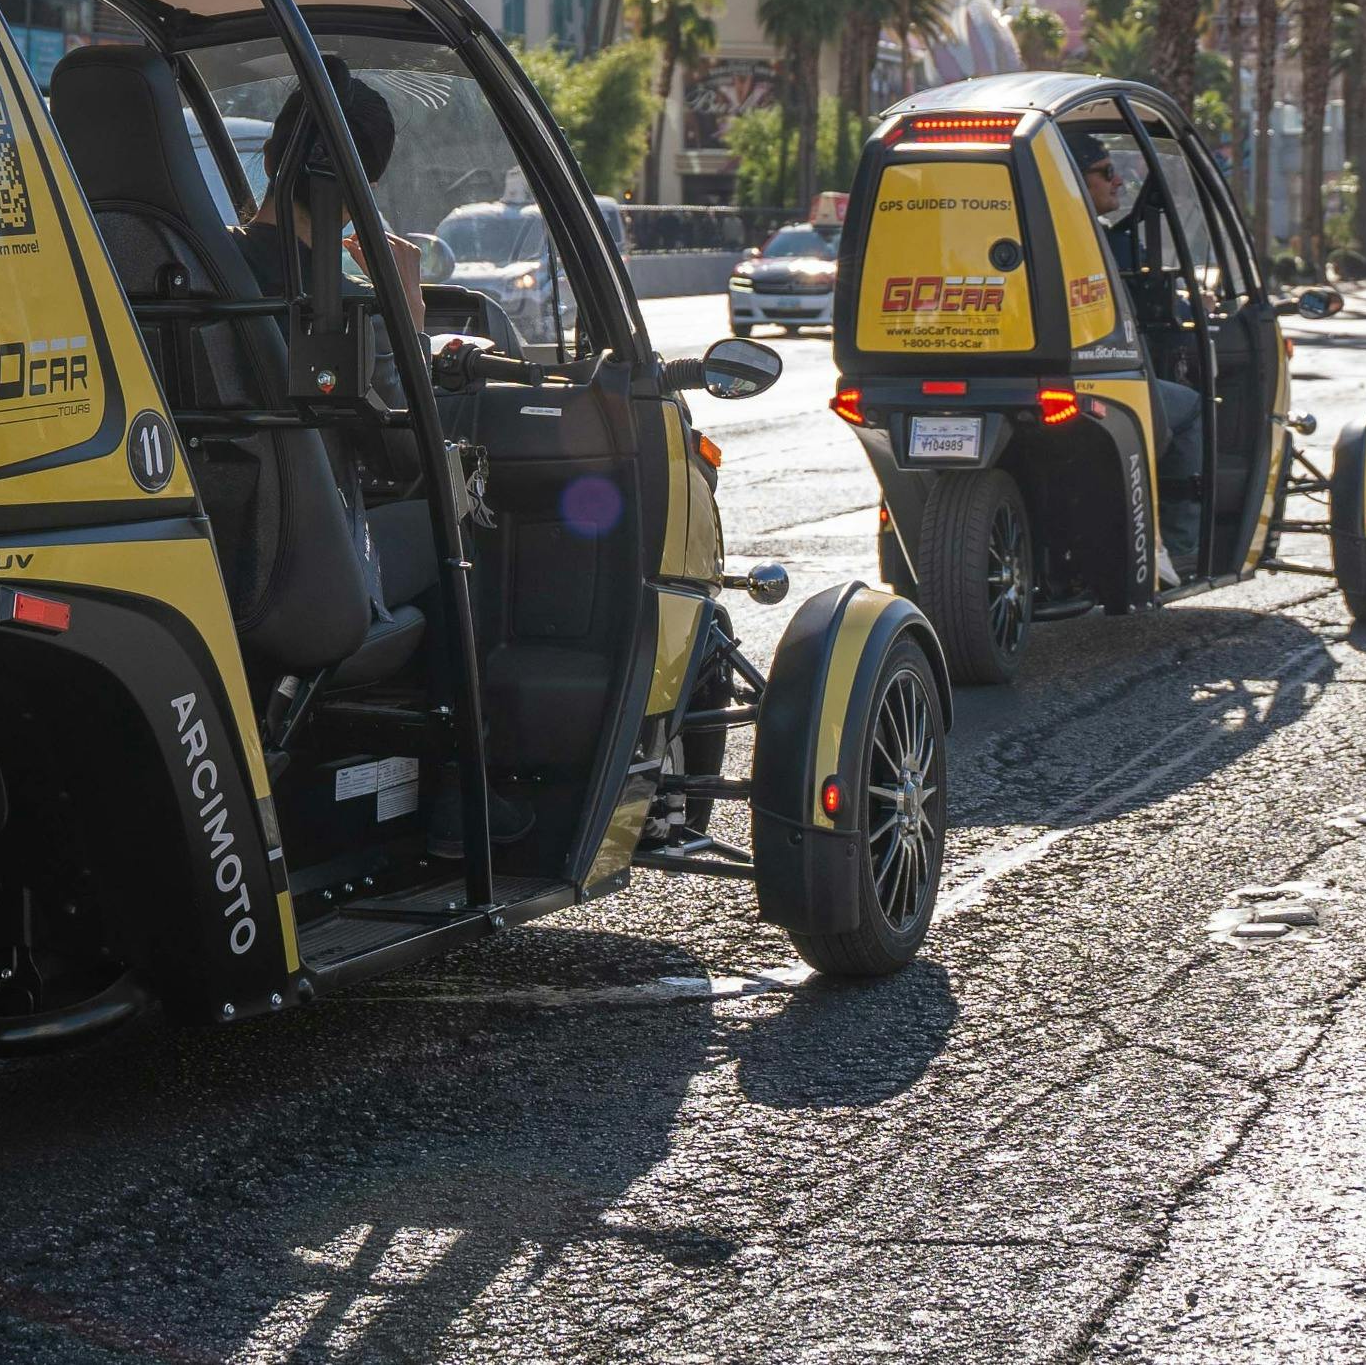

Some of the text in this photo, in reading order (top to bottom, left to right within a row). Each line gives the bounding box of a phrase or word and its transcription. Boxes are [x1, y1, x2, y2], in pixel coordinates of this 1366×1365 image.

[878, 198, 1012, 212] GPS GUIDED TOURS!
[12, 240, 40, 254] more!
[886, 326, 1000, 336] www.GoCarTours.com
[902, 338, 983, 349] 1-800-91-GoCar
[58, 403, 91, 417] TOURS
[139, 424, 164, 477] 11
[1129, 453, 1148, 584] ARCIMOTO
[170, 692, 257, 955] ARCIMOTO
